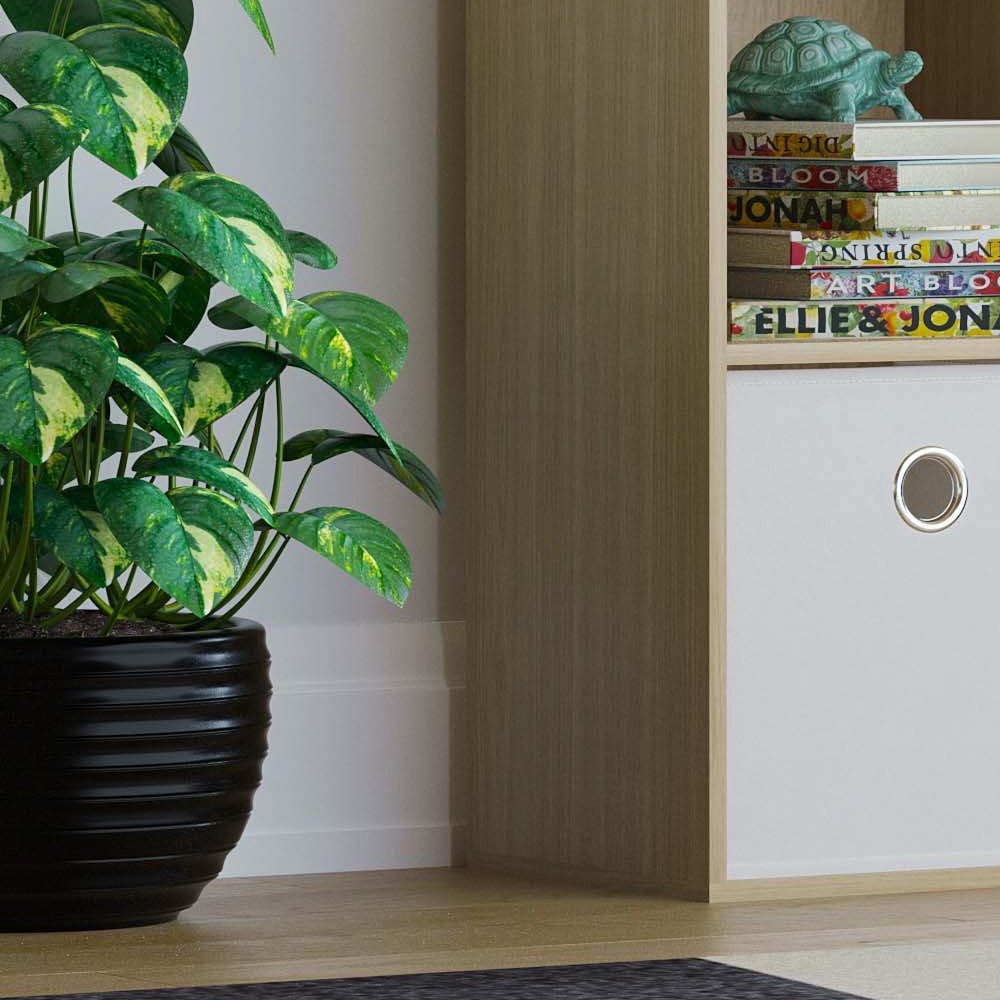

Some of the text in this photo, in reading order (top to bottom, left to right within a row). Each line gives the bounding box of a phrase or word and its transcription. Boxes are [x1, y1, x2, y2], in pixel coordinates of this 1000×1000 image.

[799, 136, 840, 154] DIG
[748, 166, 869, 185] BLOOM
[729, 195, 848, 224] JONAH
[821, 242, 922, 262] SPRING
[826, 274, 902, 296] ART
[754, 306, 849, 335] ELLIE
